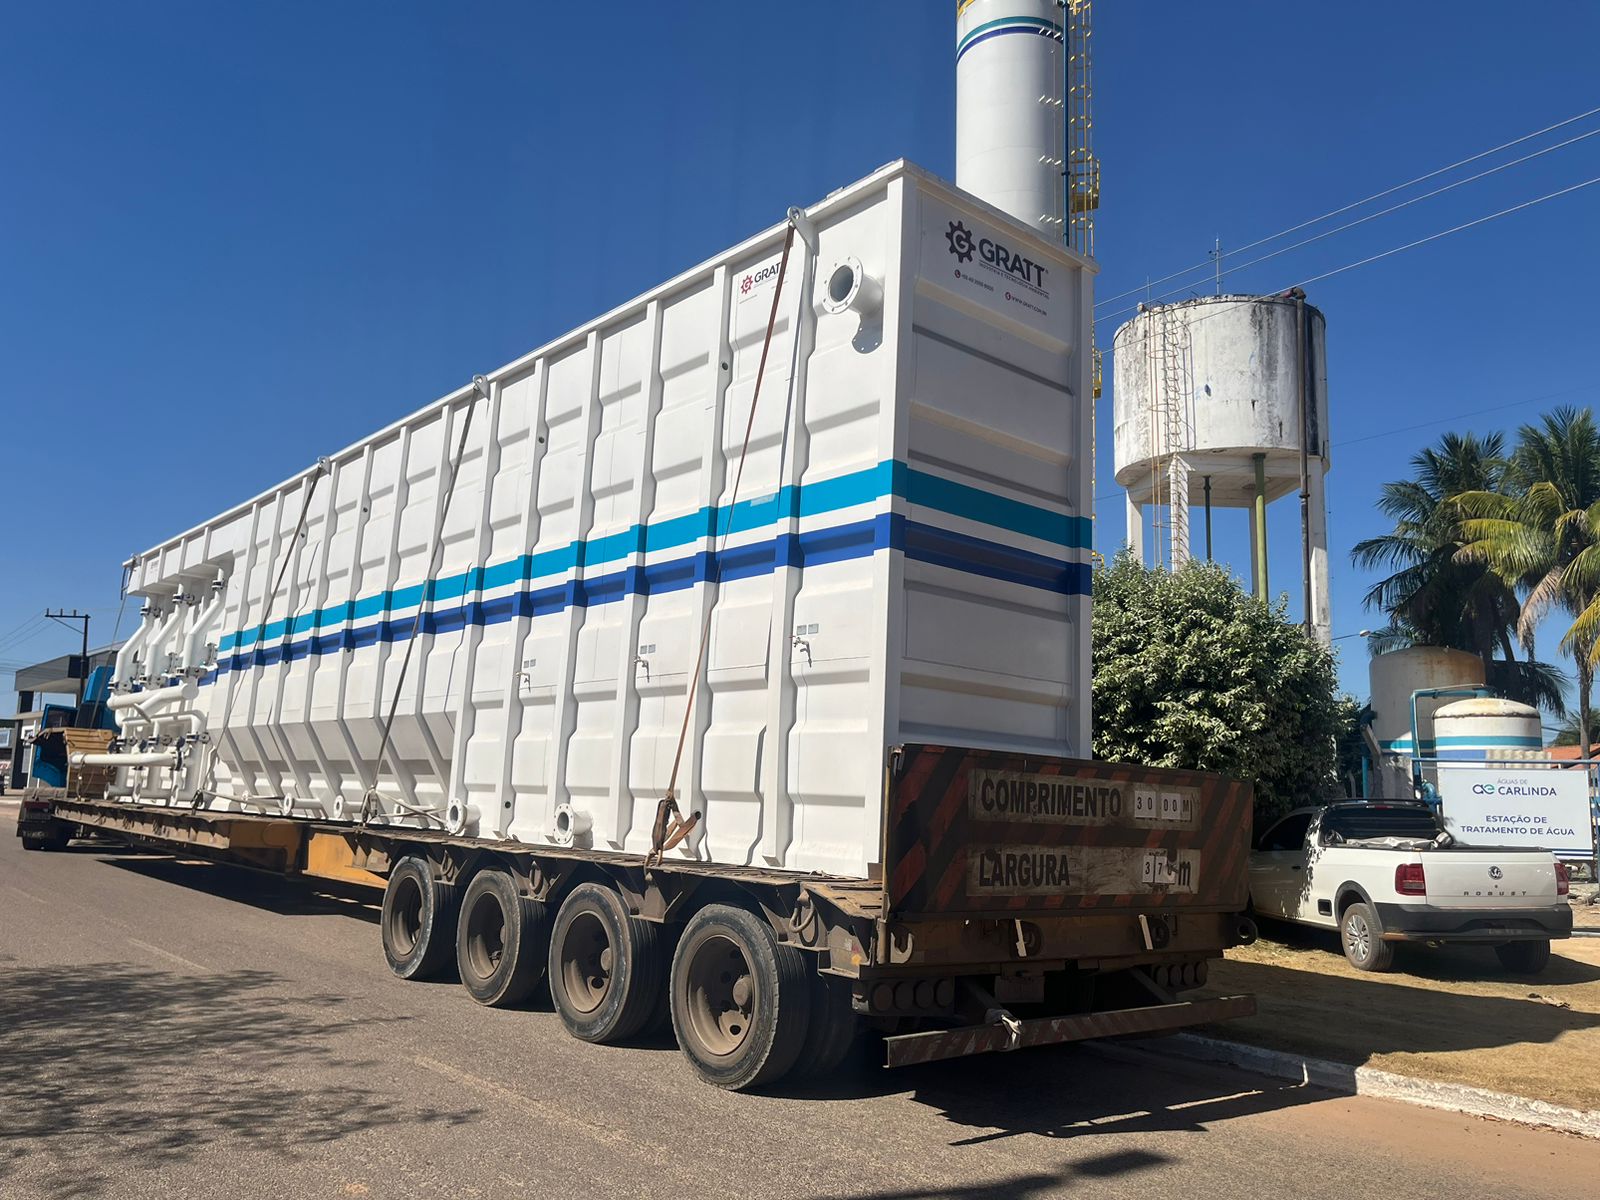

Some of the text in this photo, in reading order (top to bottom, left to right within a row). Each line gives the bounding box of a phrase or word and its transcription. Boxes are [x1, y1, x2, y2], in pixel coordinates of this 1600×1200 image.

[978, 238, 1045, 288] GRATT
[754, 262, 781, 283] GRAT
[1497, 777, 1518, 785] ÁGUAS
[981, 778, 1122, 818] COMPRIMENTO
[1498, 786, 1557, 796] CARLINDA
[1485, 815, 1547, 824] ESTAÇÃO DE
[1460, 825, 1575, 836] TRATAMENTO DE ÁGUA
[979, 852, 1070, 887] LARGURA
